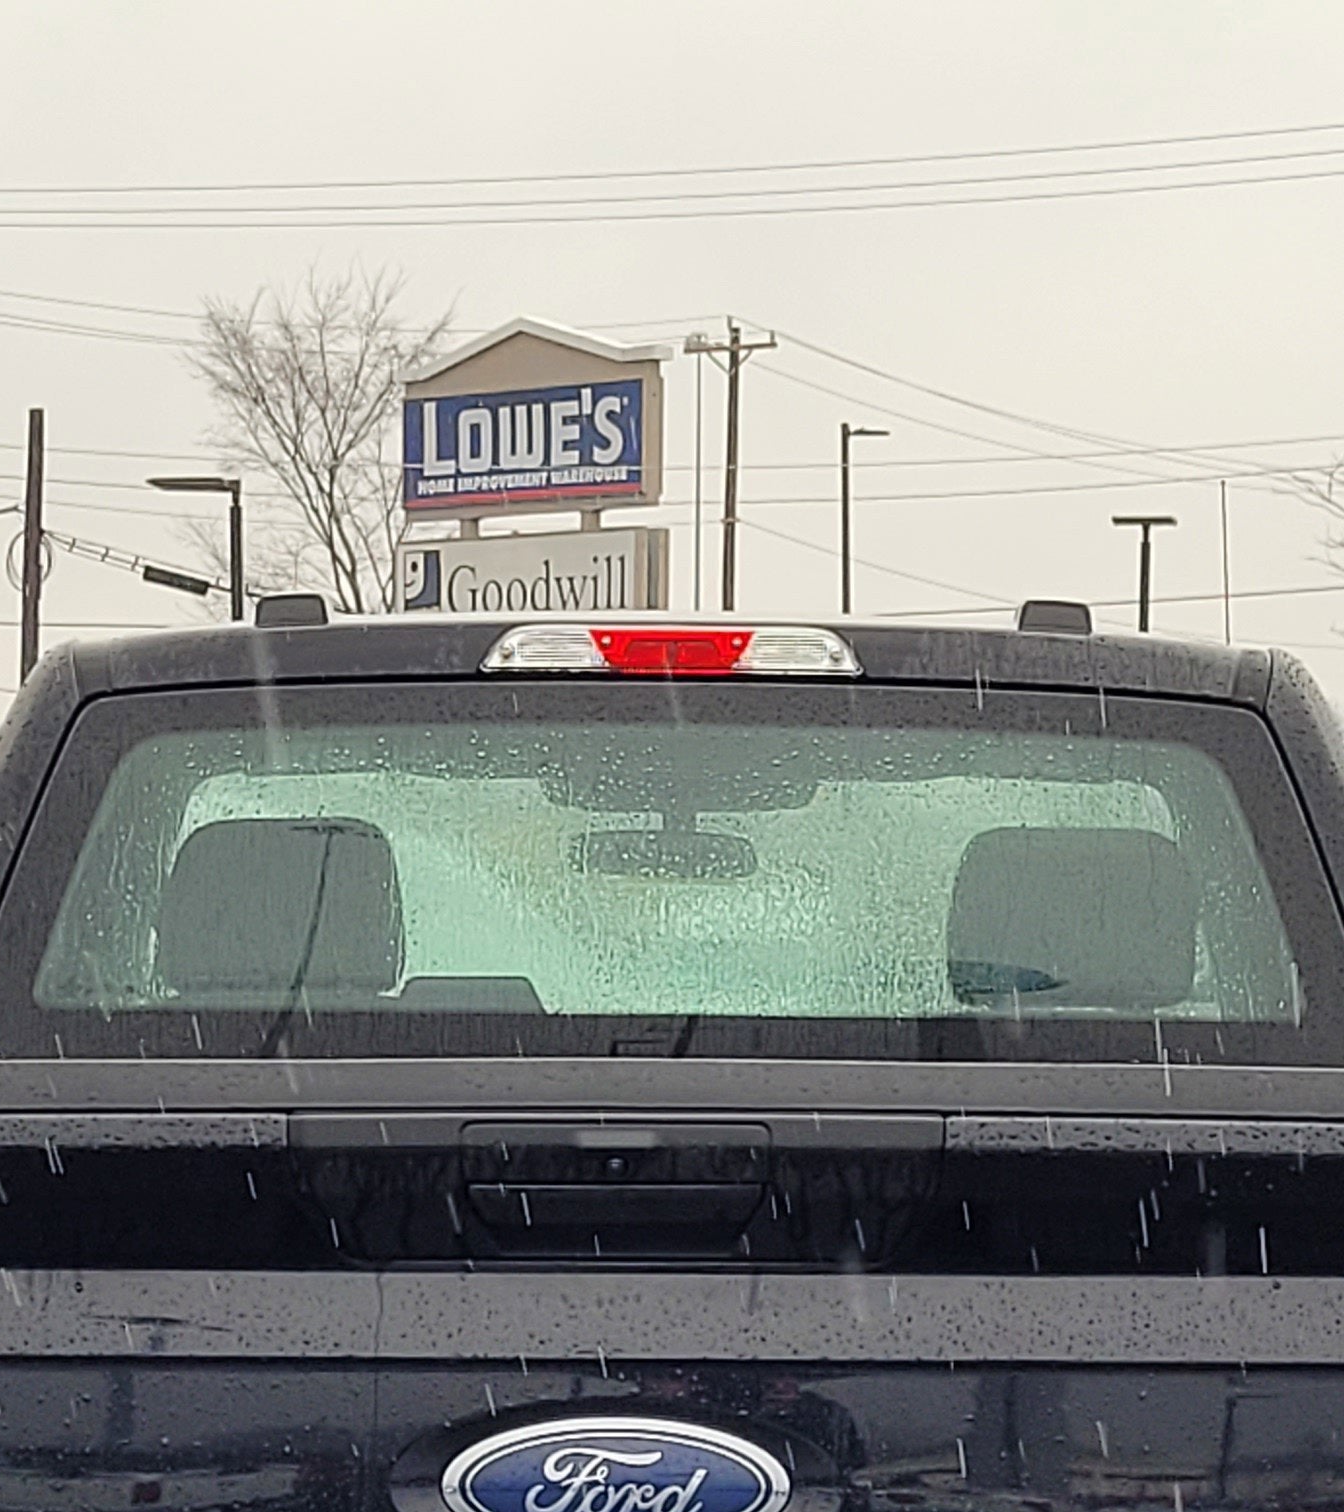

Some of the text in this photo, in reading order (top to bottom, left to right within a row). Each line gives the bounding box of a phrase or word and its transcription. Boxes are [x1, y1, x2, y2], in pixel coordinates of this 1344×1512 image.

[422, 387, 625, 477] LOWE'S
[417, 466, 629, 496] HOME IMPROVEMENT WAREHOUSE
[447, 554, 627, 611] Goodwill
